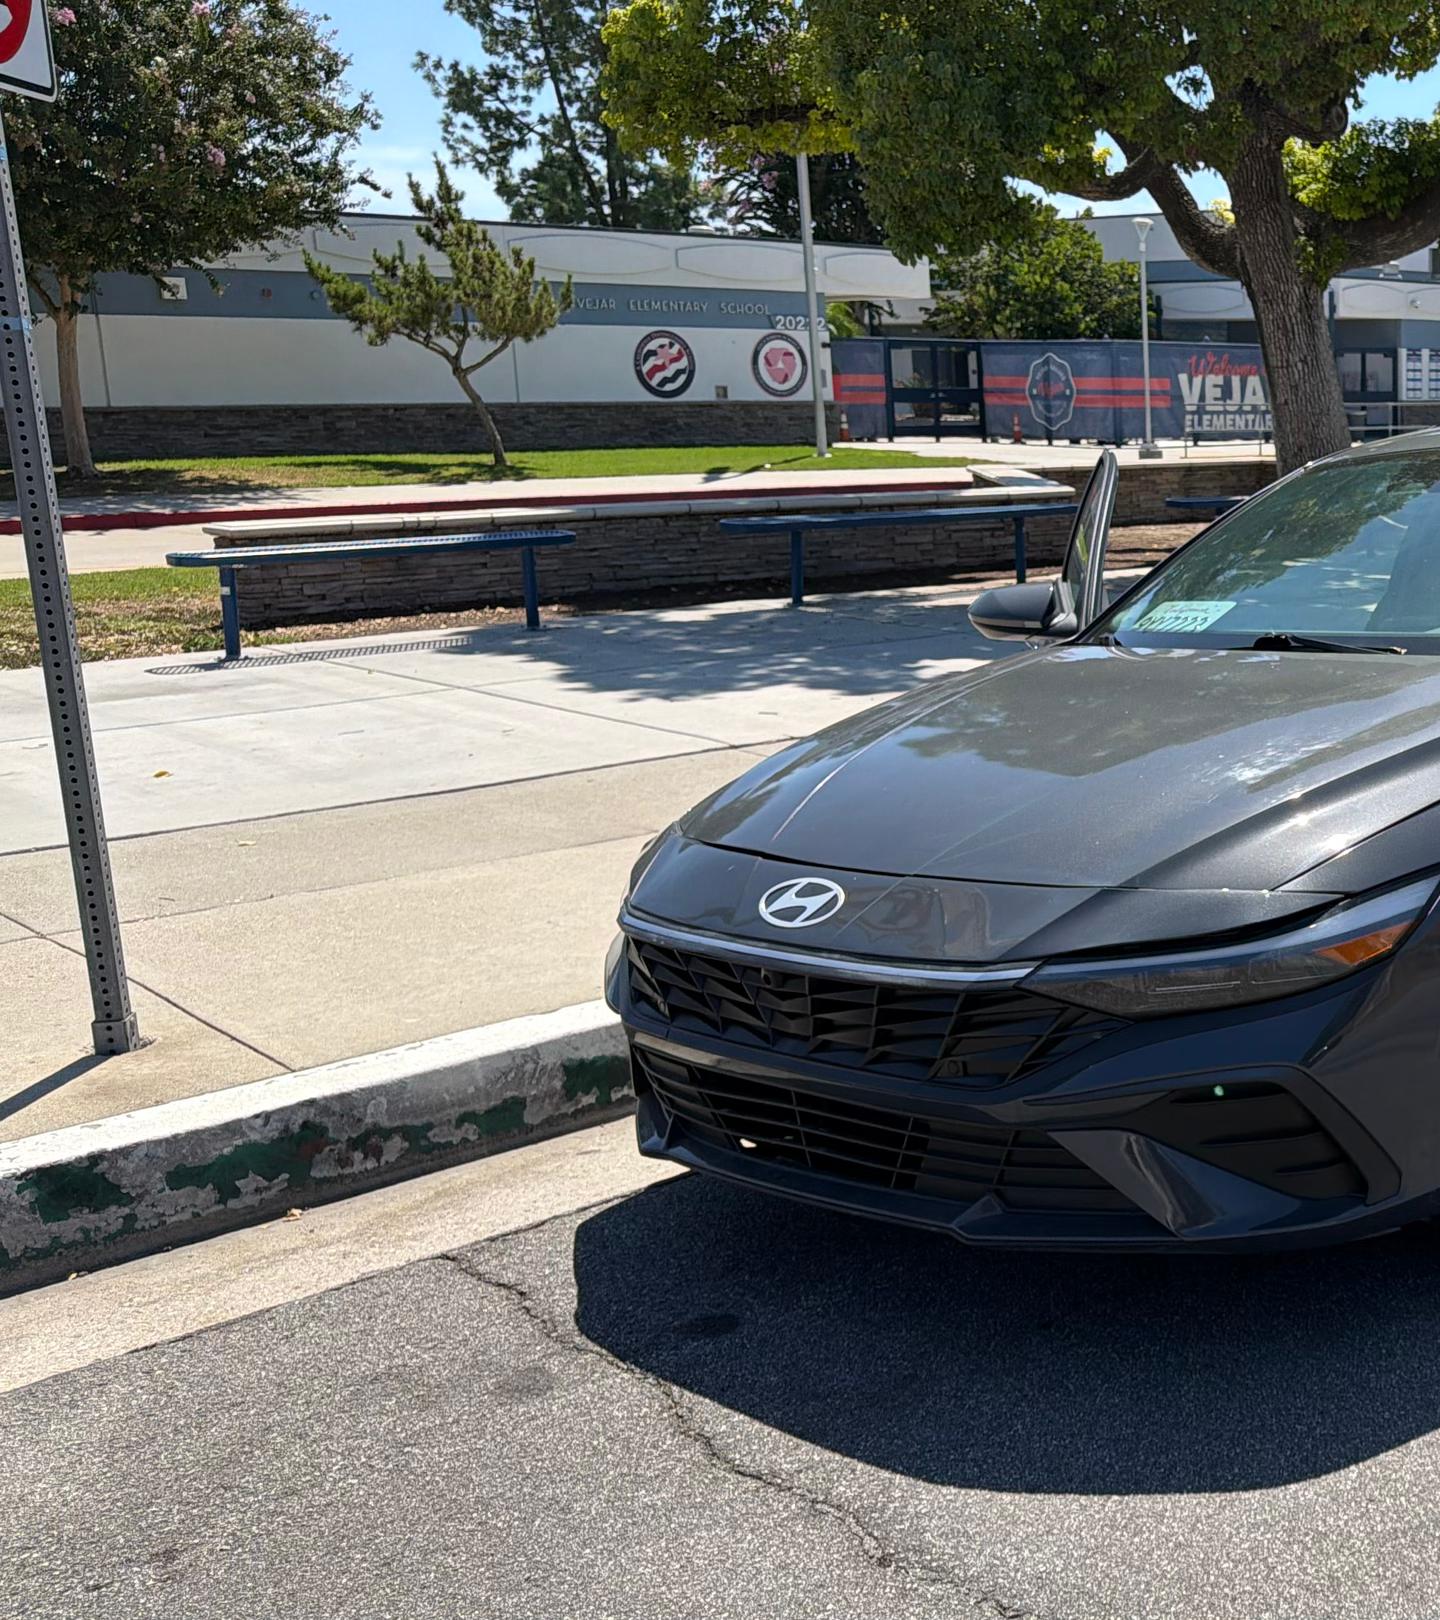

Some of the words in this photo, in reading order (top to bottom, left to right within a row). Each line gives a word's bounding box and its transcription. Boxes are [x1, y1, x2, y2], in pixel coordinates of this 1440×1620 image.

[577, 298, 616, 310] VEJAR
[629, 299, 709, 314] ELEMENTARY
[719, 303, 771, 316] SCHOOL
[775, 315, 826, 331] 2022
[1188, 351, 1259, 377] Welcome
[1177, 373, 1272, 412] VEJA
